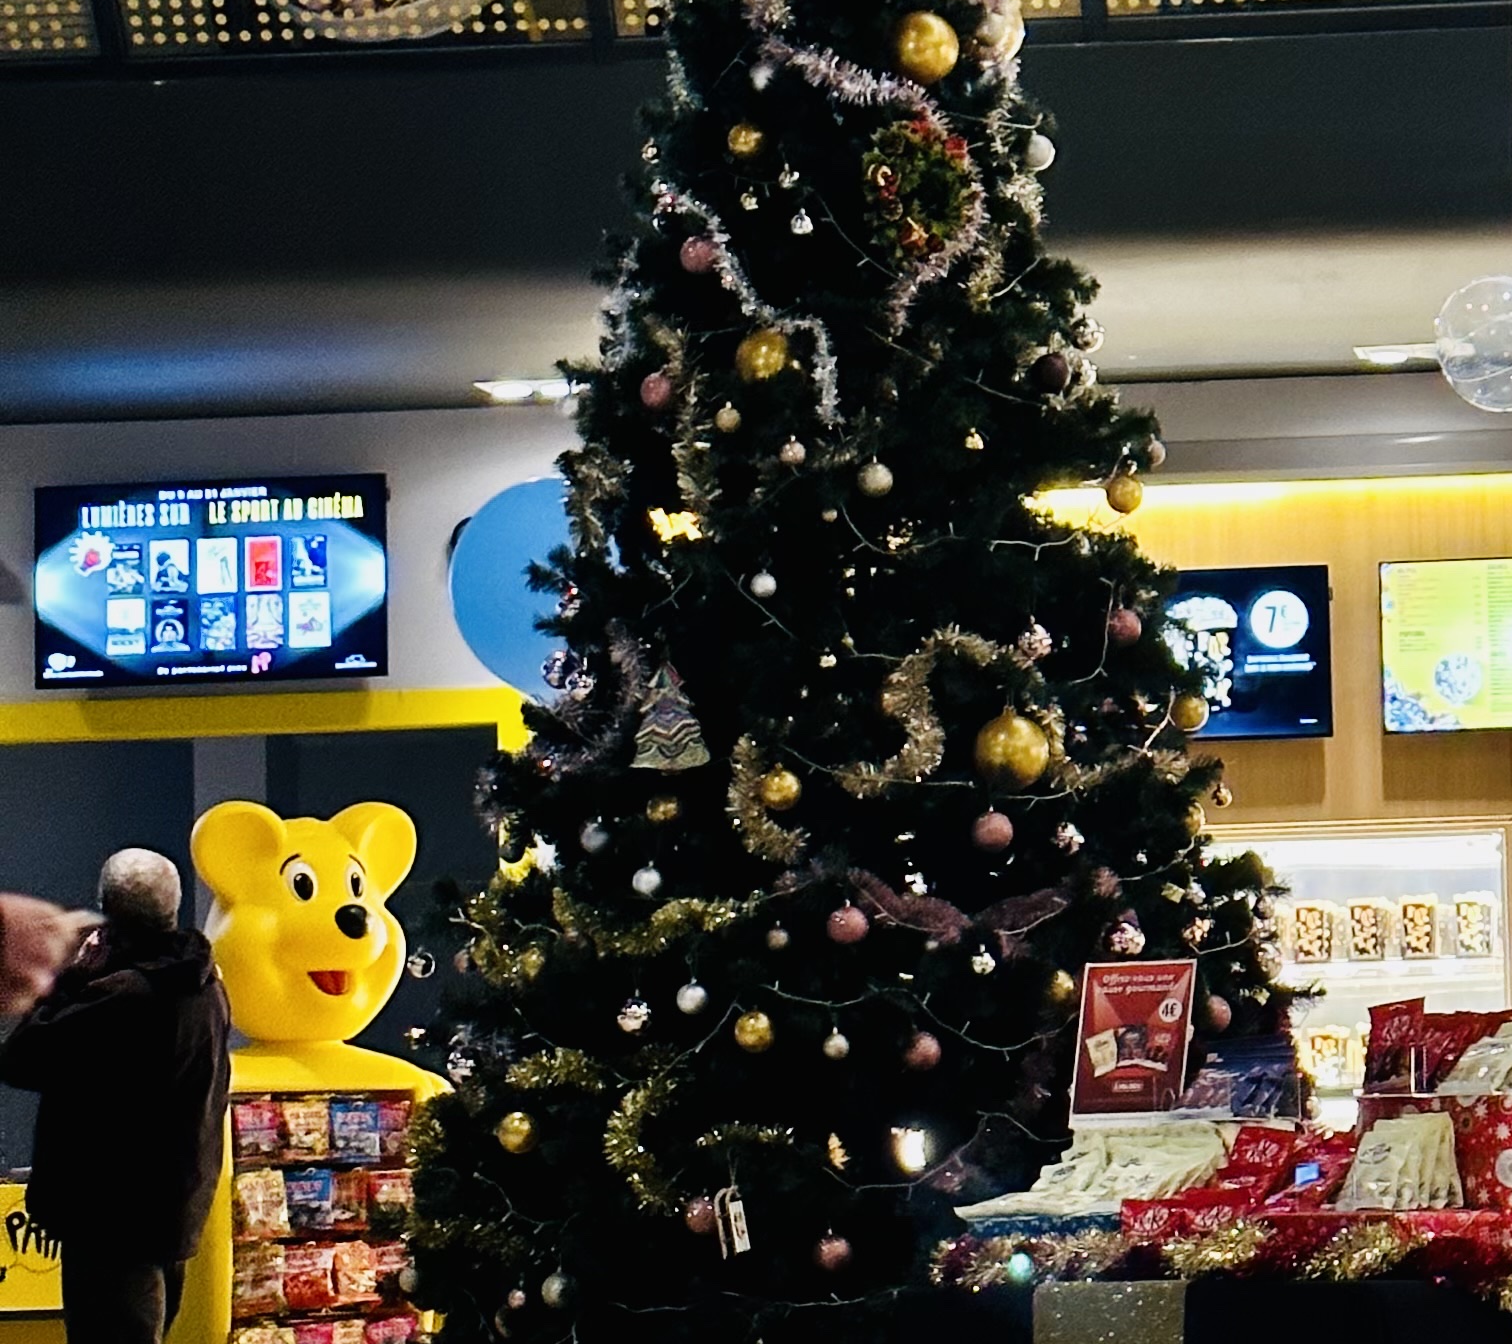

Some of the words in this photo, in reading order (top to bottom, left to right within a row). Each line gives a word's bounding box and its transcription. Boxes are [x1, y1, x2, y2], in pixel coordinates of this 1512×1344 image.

[159, 503, 190, 527] SUR
[208, 500, 227, 525] LE
[230, 498, 280, 524] SPORT
[282, 497, 303, 521] AU
[307, 492, 364, 520] CINÉMA
